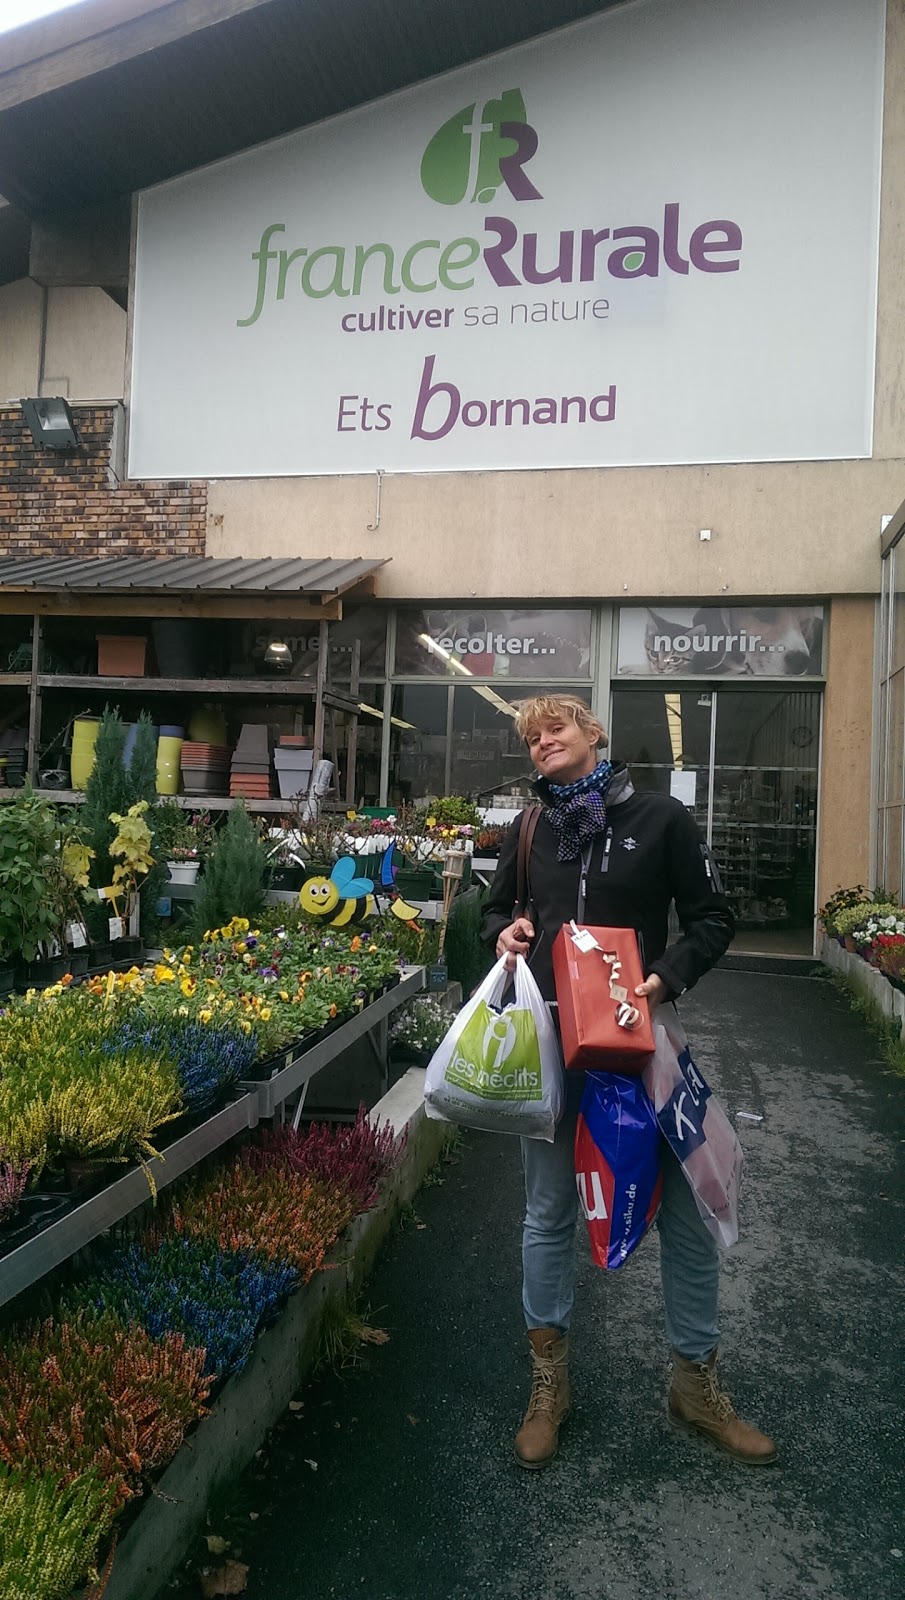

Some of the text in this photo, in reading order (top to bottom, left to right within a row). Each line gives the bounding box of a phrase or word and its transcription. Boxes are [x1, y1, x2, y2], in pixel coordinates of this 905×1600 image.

[341, 297, 610, 332] cultiver sa nature
[337, 354, 617, 440] Ets bornand
[654, 629, 785, 652] nourrir...
[450, 1050, 538, 1088] les inédits
